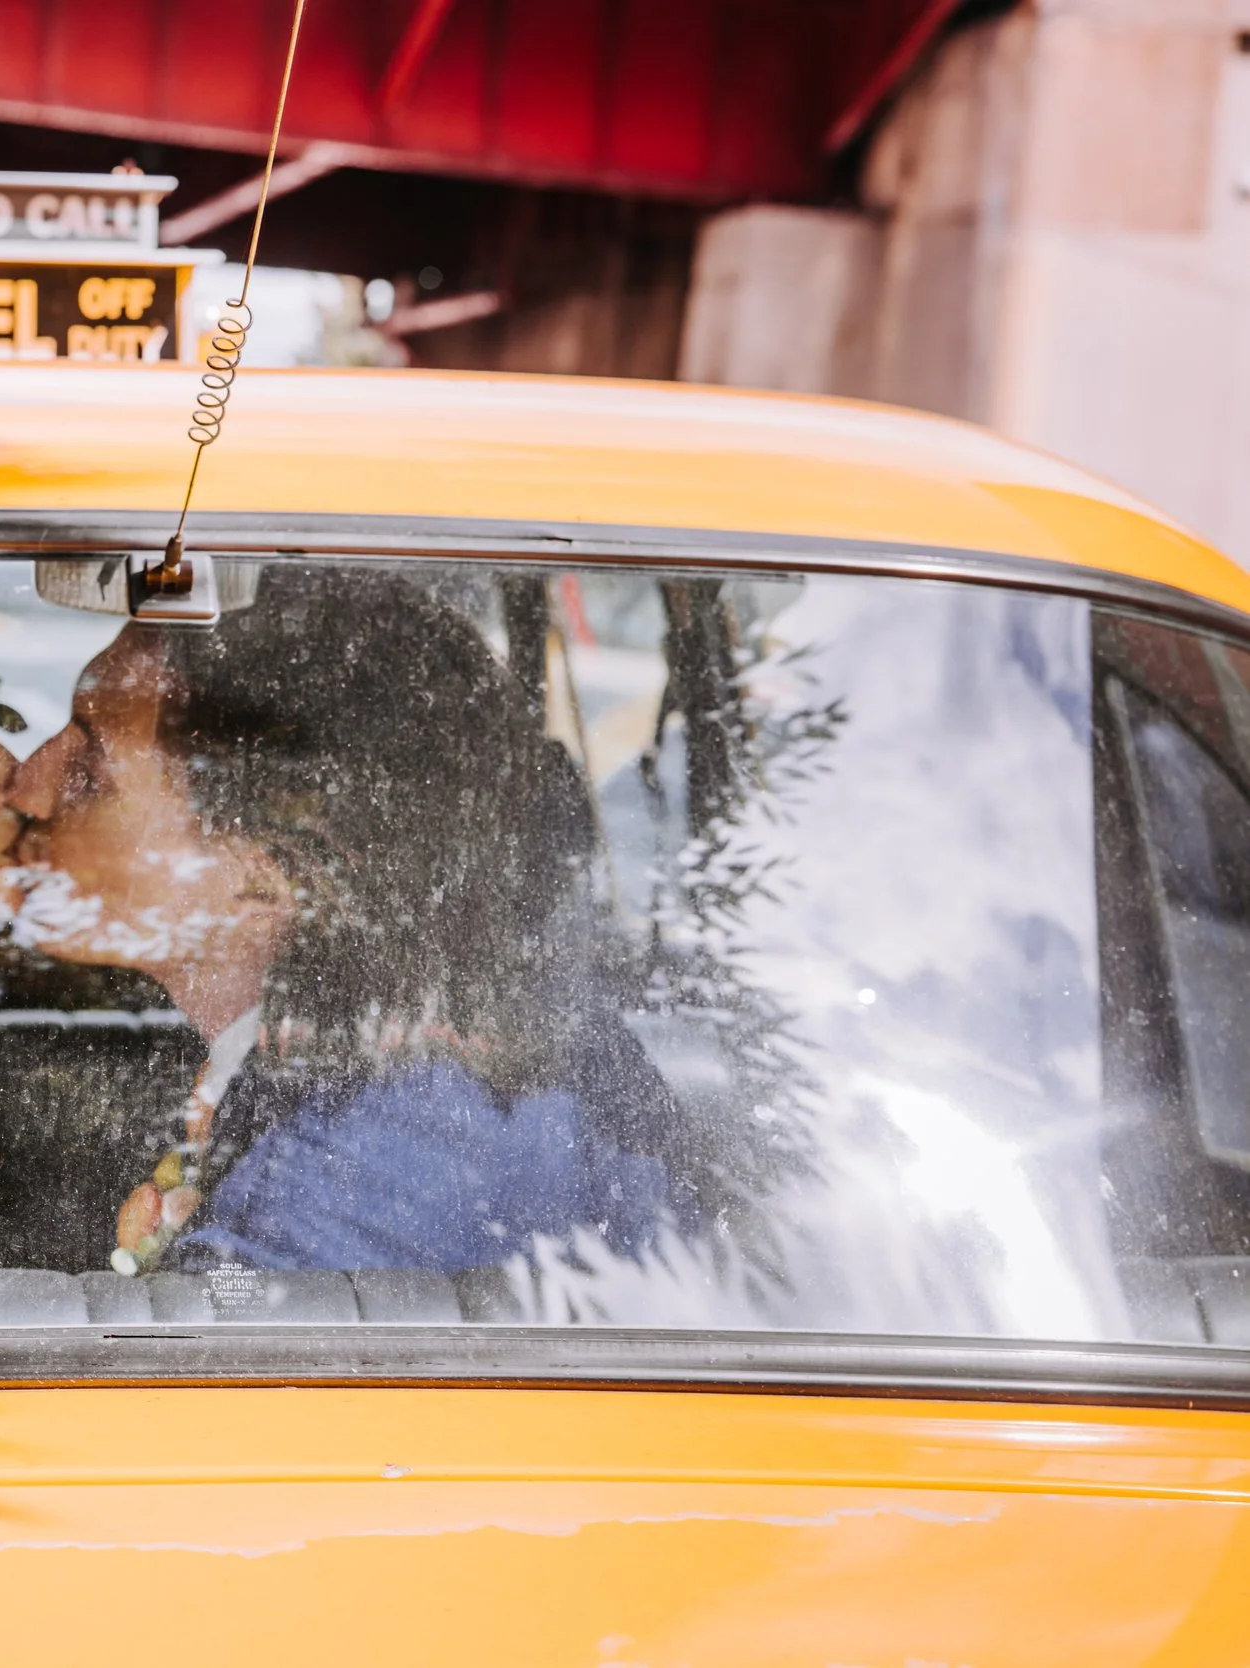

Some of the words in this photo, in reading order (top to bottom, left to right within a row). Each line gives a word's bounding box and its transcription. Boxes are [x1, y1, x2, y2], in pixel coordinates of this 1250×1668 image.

[25, 193, 143, 240] CALL
[78, 277, 156, 320] OFF
[67, 323, 168, 362] DUTY
[212, 1278, 253, 1290] Carlite
